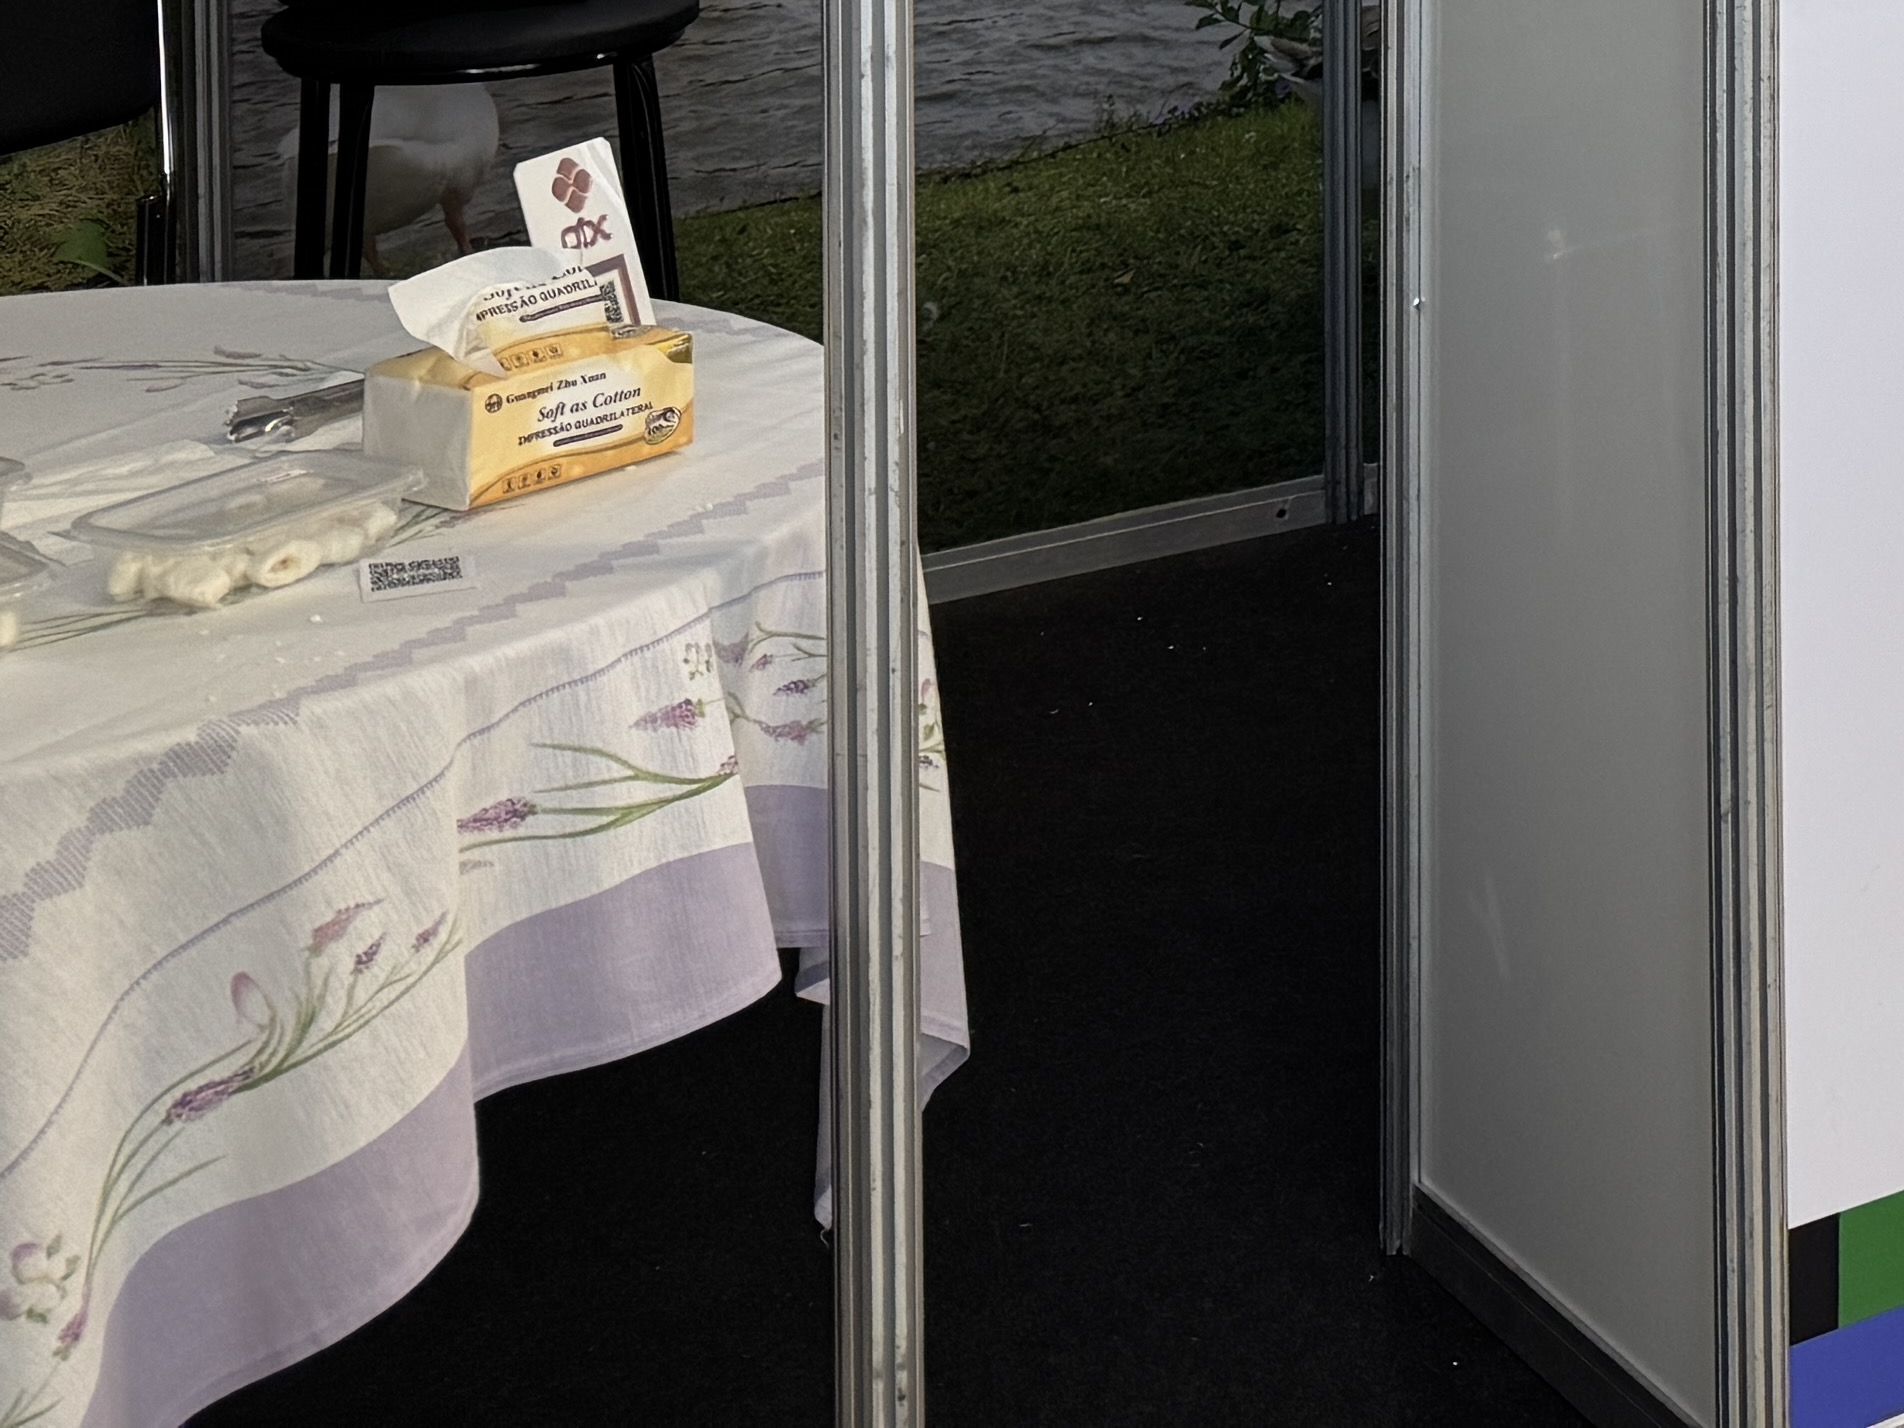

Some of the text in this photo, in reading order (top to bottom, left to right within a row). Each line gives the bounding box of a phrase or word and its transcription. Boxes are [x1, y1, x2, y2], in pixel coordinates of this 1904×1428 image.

[536, 387, 642, 423] Soft as Cotton
[518, 422, 573, 445] IMPRESSÃO
